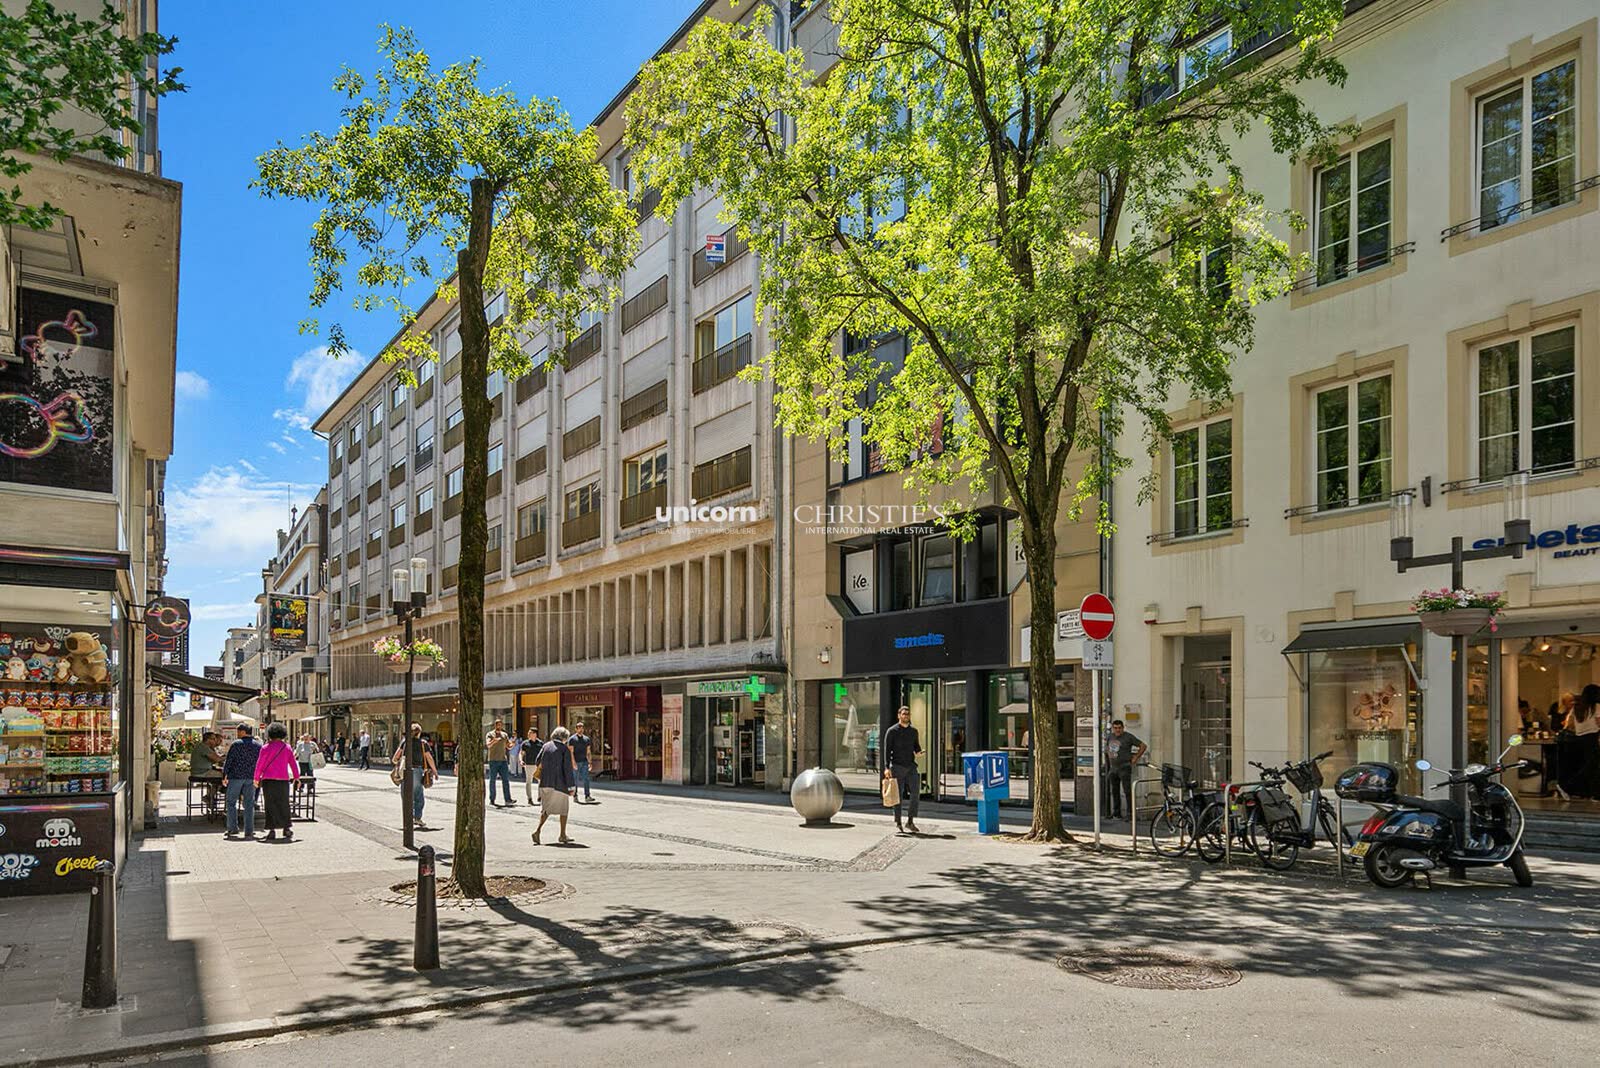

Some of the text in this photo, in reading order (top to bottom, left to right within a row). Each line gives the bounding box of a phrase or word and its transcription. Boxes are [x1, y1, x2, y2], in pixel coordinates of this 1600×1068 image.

[1553, 546, 1600, 559] BEAUT
[894, 632, 945, 649] smets
[35, 835, 82, 848] mochi
